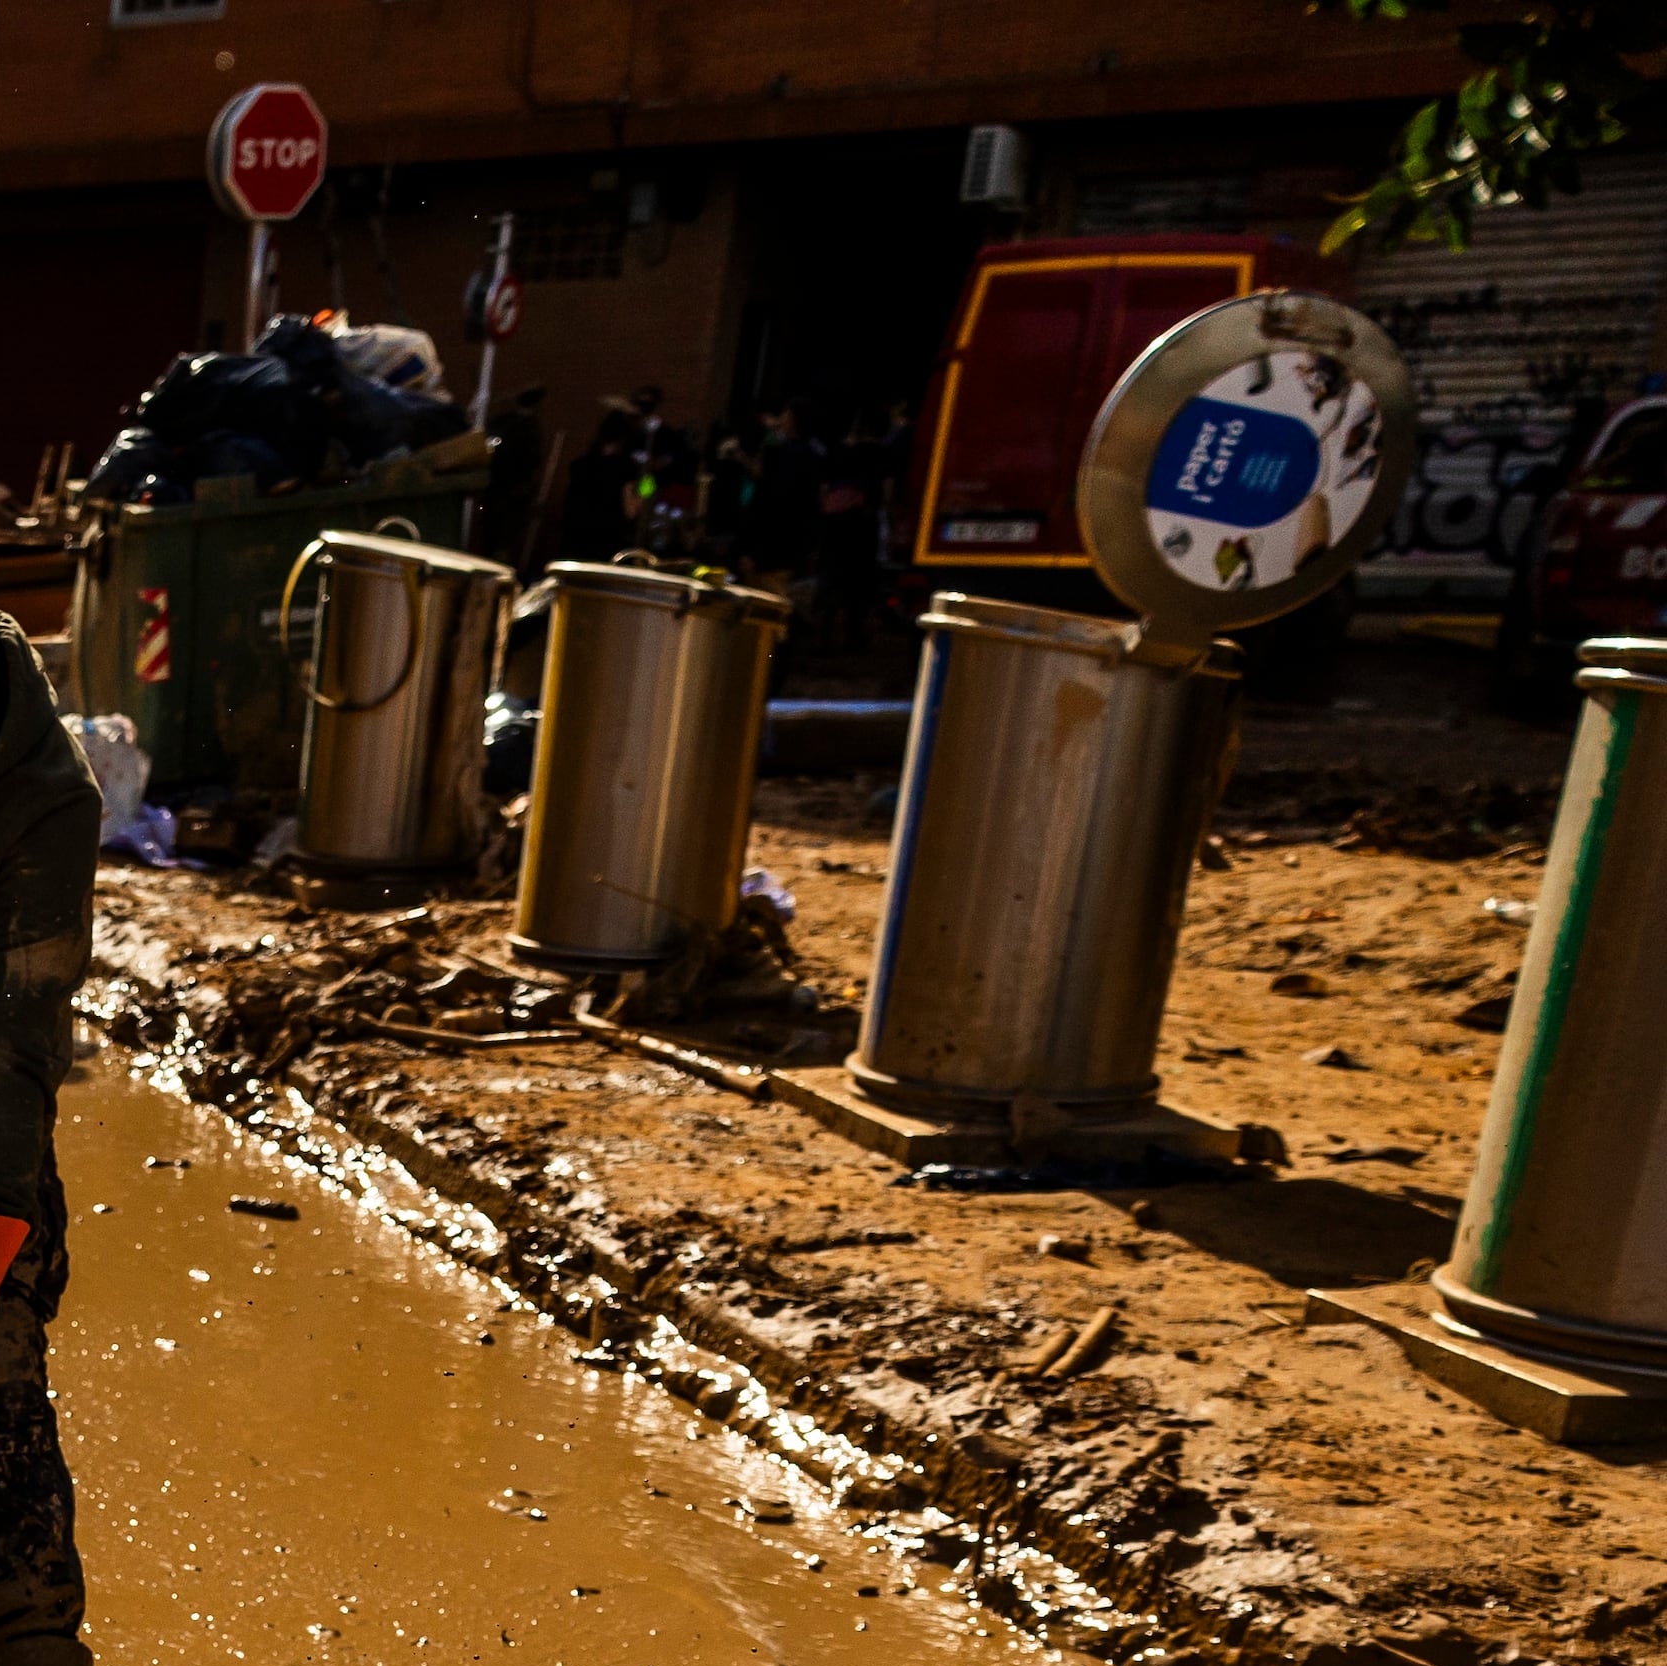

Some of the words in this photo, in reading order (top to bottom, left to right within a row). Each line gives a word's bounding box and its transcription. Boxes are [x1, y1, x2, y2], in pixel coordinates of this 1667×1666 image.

[238, 137, 317, 169] STOP
[1176, 421, 1219, 492] paper
[1207, 417, 1247, 487] cartó
